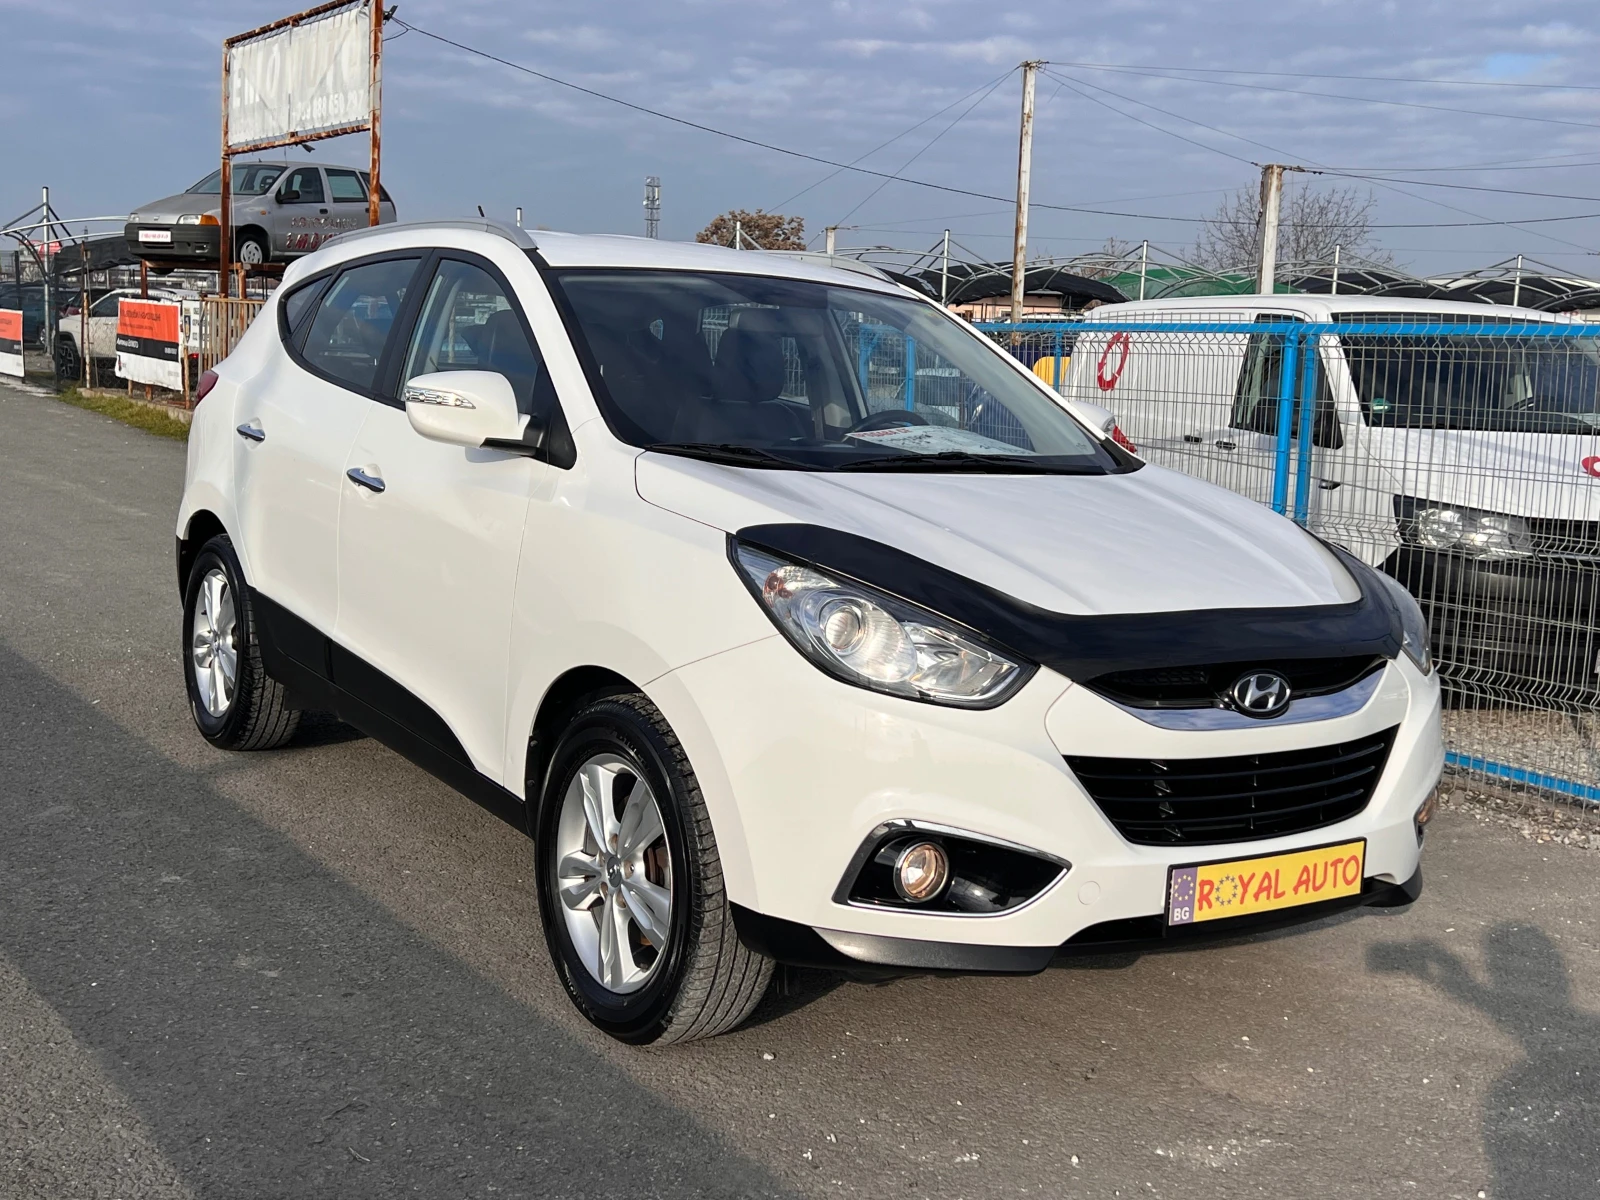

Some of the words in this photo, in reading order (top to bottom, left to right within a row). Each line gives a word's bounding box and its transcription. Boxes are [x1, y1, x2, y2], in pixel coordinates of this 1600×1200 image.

[1197, 869, 1285, 911] ROYAL
[1293, 855, 1360, 895] AUTO
[1173, 906, 1190, 922] BG
